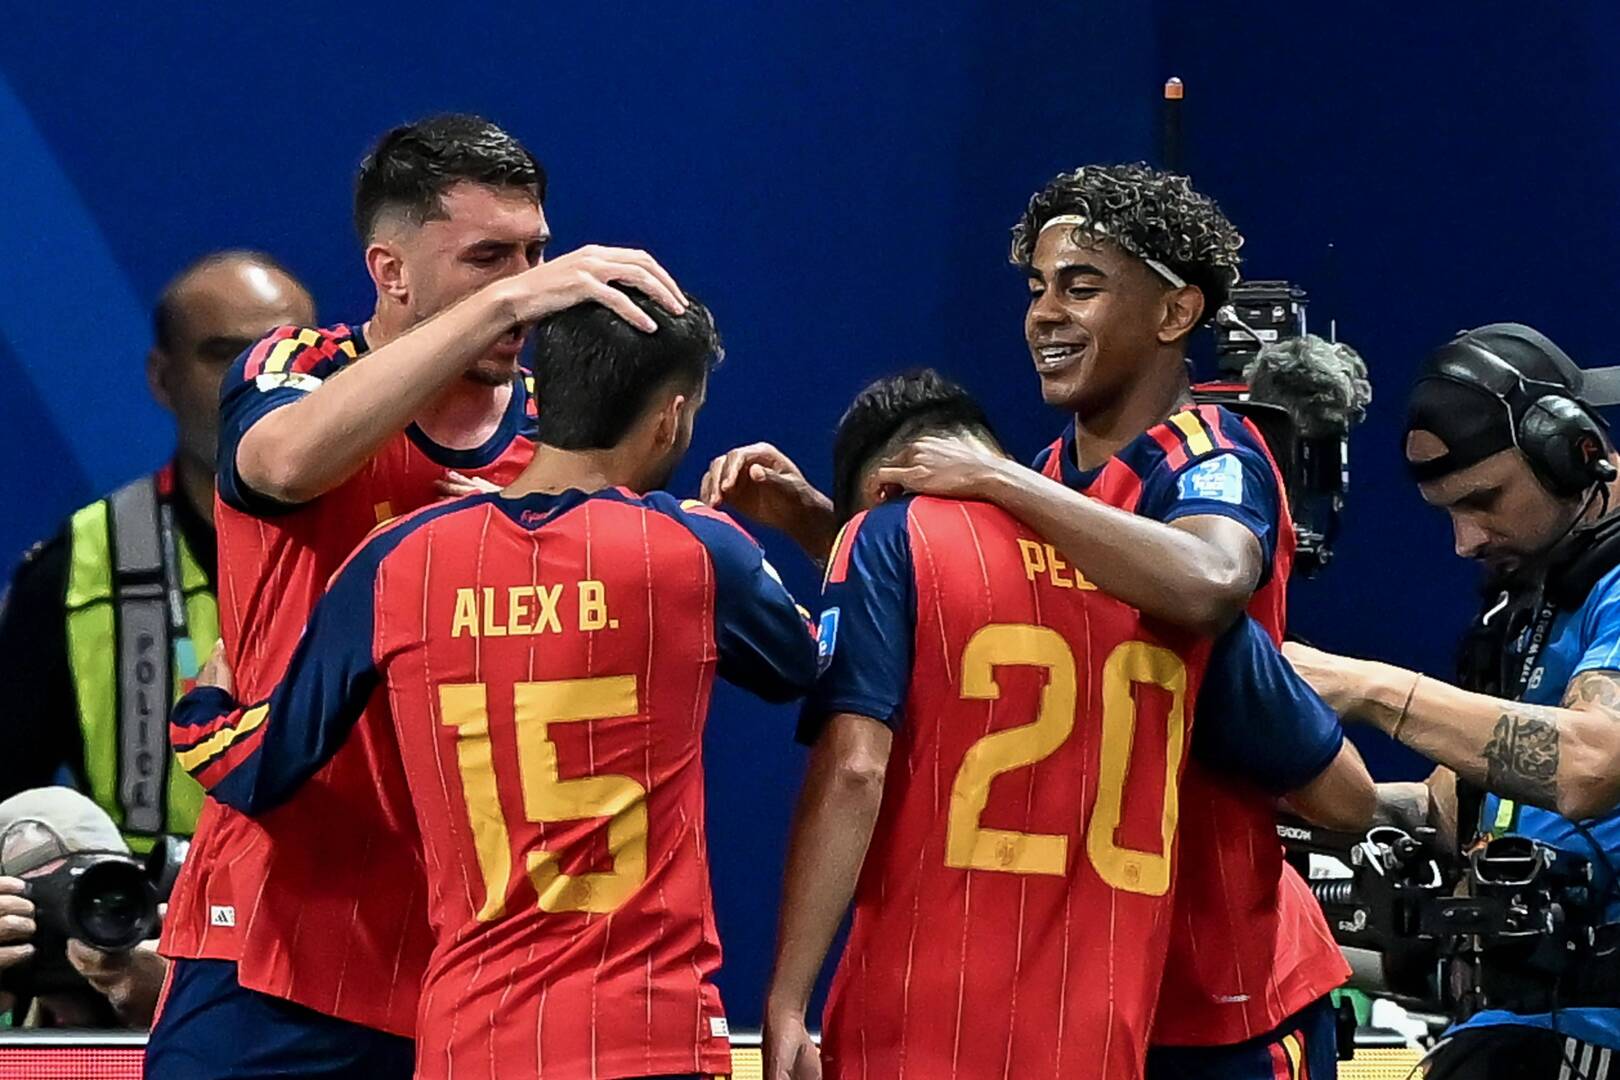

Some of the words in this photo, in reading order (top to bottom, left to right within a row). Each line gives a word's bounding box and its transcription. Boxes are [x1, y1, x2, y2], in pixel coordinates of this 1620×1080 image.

[452, 585, 562, 637] ALEX
[578, 580, 619, 632] B.
[439, 675, 648, 922] 15
[947, 624, 1187, 895] 20
